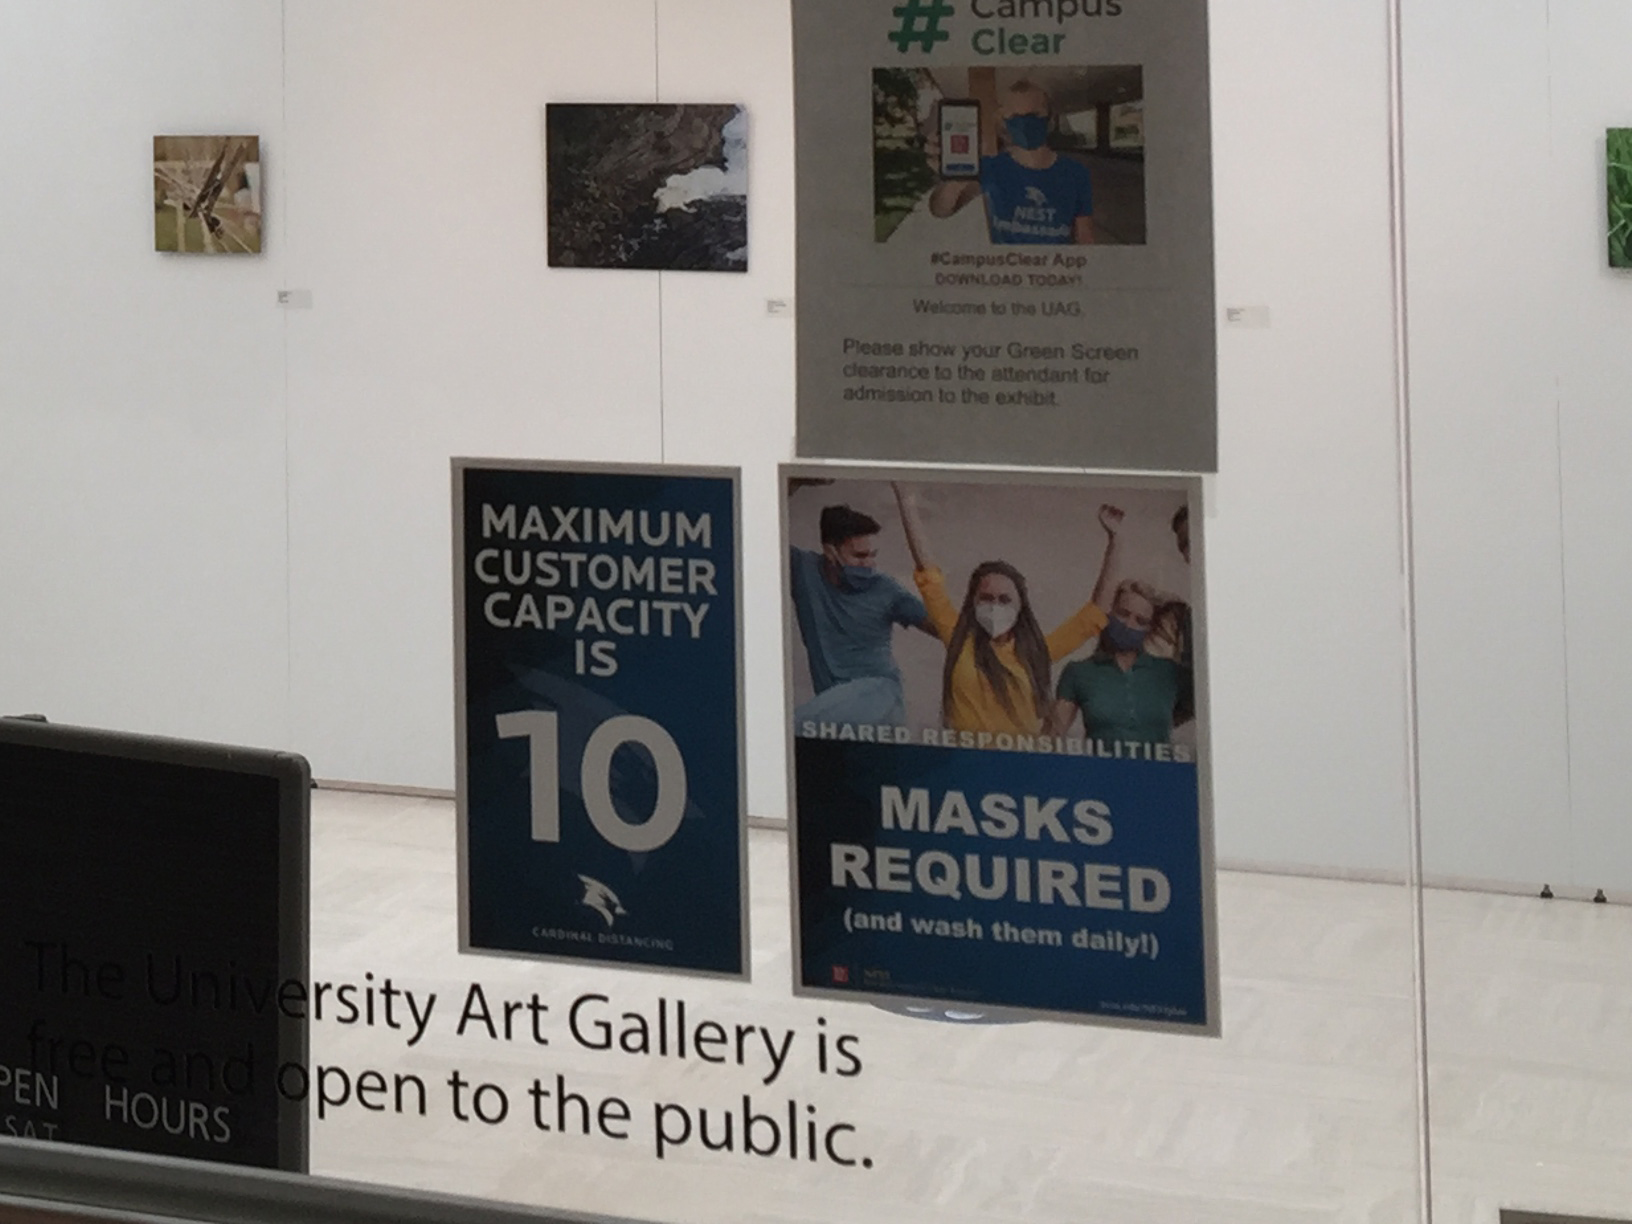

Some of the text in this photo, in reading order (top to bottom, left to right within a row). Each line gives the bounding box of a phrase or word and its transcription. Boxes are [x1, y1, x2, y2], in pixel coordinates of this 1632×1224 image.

[971, 28, 1066, 56] Clear
[930, 251, 1088, 268] #CampusClear App
[934, 273, 1083, 287] DOWNLOAD TODAY!
[912, 298, 987, 316] Welcome
[990, 300, 1006, 316] to
[1010, 300, 1036, 316] the
[842, 337, 1139, 362] Please show your Green Screen
[842, 362, 1111, 384] clearance to the attendant for
[842, 385, 933, 403] admission
[938, 386, 957, 404] to
[961, 387, 990, 405] the
[481, 502, 713, 549] MAXIMUM
[473, 548, 718, 597] CUSTOMER
[483, 591, 710, 639] CAPACITY
[574, 638, 619, 677] IS
[801, 719, 1192, 764] SHARED RESPONSIBILITIES
[494, 708, 688, 853] 10
[879, 784, 1115, 847] MASKS
[829, 842, 1171, 915] REQUIRED
[531, 925, 676, 952] CARDINAL DISTANCING
[842, 906, 1160, 960] (and wash them daily!)
[23, 939, 863, 1085] The University Art Gallery is
[26, 1019, 873, 1170] free and open to the public.
[104, 1084, 231, 1144] HOURS
